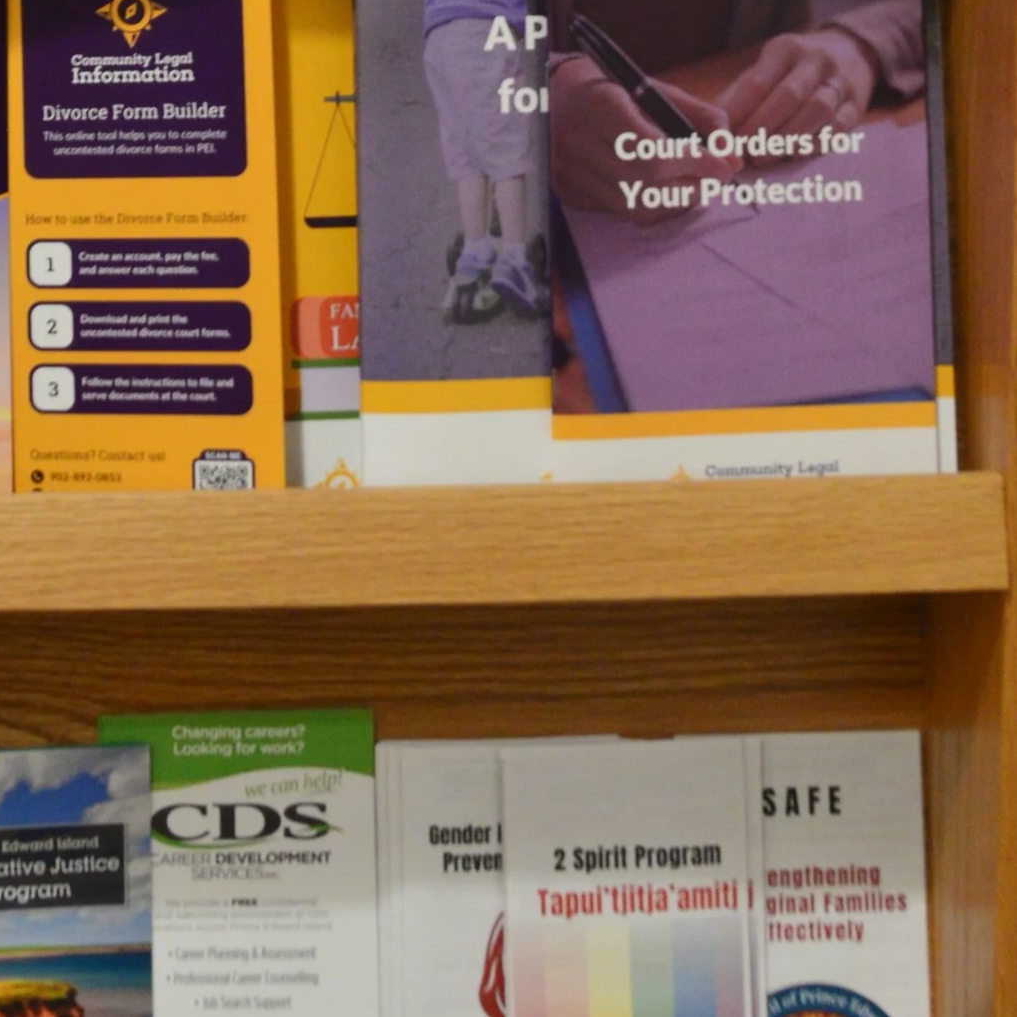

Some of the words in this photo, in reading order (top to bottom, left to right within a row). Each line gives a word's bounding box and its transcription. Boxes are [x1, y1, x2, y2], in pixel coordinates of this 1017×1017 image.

[484, 16, 515, 51] A
[71, 54, 151, 67] Community
[154, 52, 193, 65] Legal
[72, 66, 194, 83] Information
[43, 105, 108, 121] Divorce
[112, 104, 158, 120] Form
[163, 102, 226, 118] Builder
[615, 132, 701, 160] Court
[709, 129, 814, 158] Orders
[819, 127, 863, 154] for
[619, 179, 692, 211] Your
[700, 175, 862, 206] Protection
[47, 258, 55, 272] 1
[47, 320, 57, 334] 2
[49, 382, 58, 397] 3
[172, 726, 242, 740] Changing
[244, 724, 306, 737] careers?
[174, 742, 231, 757] Looking
[235, 742, 256, 754] for
[260, 741, 304, 754] work?
[762, 786, 841, 816] SAFE
[150, 802, 331, 842] CDS
[429, 823, 491, 845] Gender
[2, 839, 54, 853] Edward
[57, 836, 99, 850] Island
[51, 855, 119, 875] Justice
[216, 852, 330, 865] DEVELOPMENT
[554, 848, 565, 871] 2
[573, 845, 627, 874] Spirit
[635, 845, 721, 871] Program
[824, 891, 907, 913] Families
